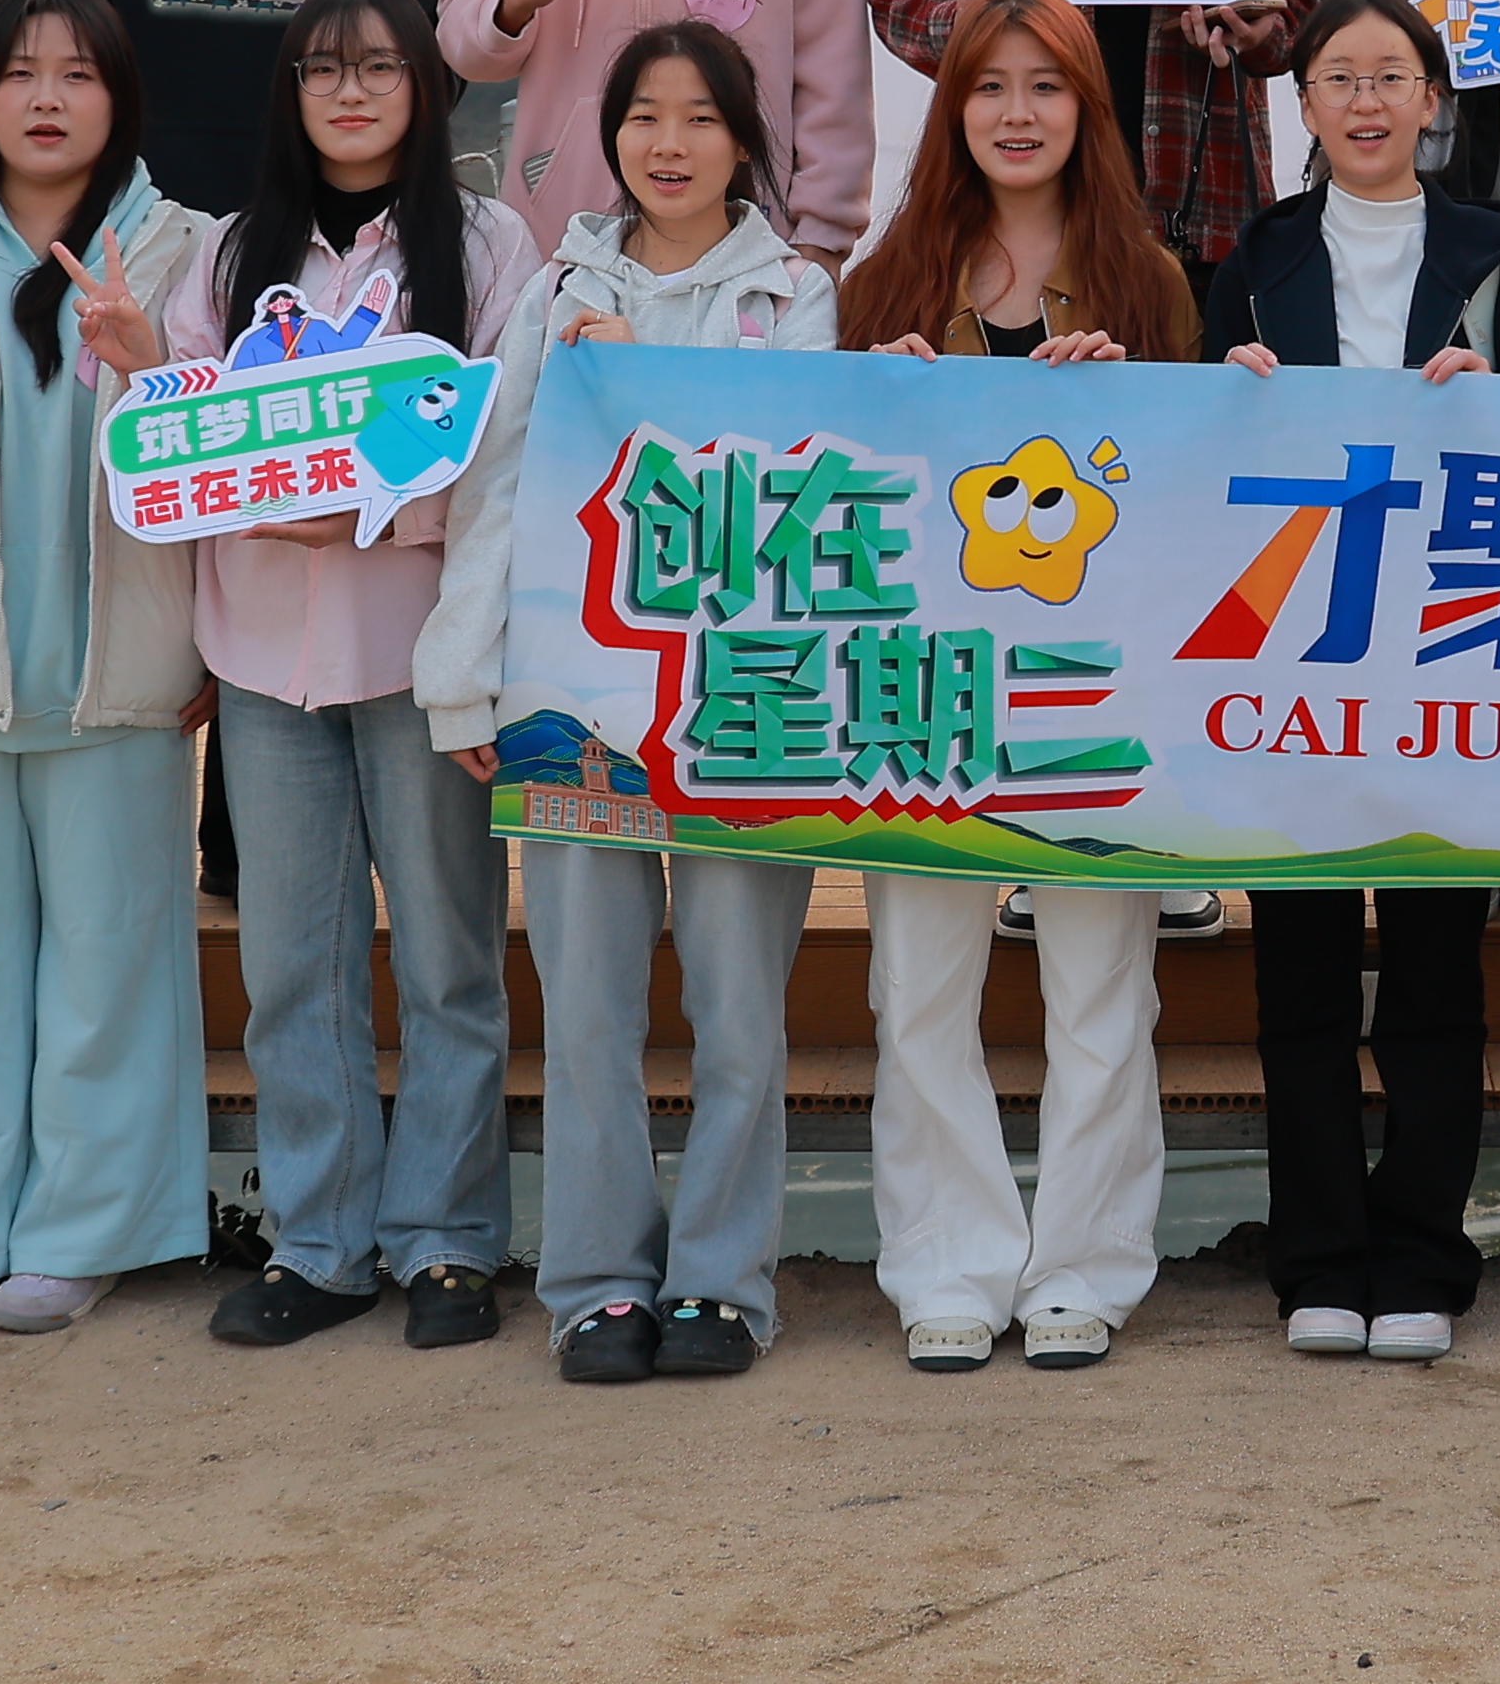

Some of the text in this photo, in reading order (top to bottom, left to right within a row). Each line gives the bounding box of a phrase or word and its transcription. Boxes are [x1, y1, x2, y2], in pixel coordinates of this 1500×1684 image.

[136, 376, 373, 464] 筑梦同行
[132, 447, 357, 527] 志在未来
[624, 439, 919, 619] 创在
[690, 623, 1153, 787] 星期二
[1206, 694, 1367, 757] CAI
